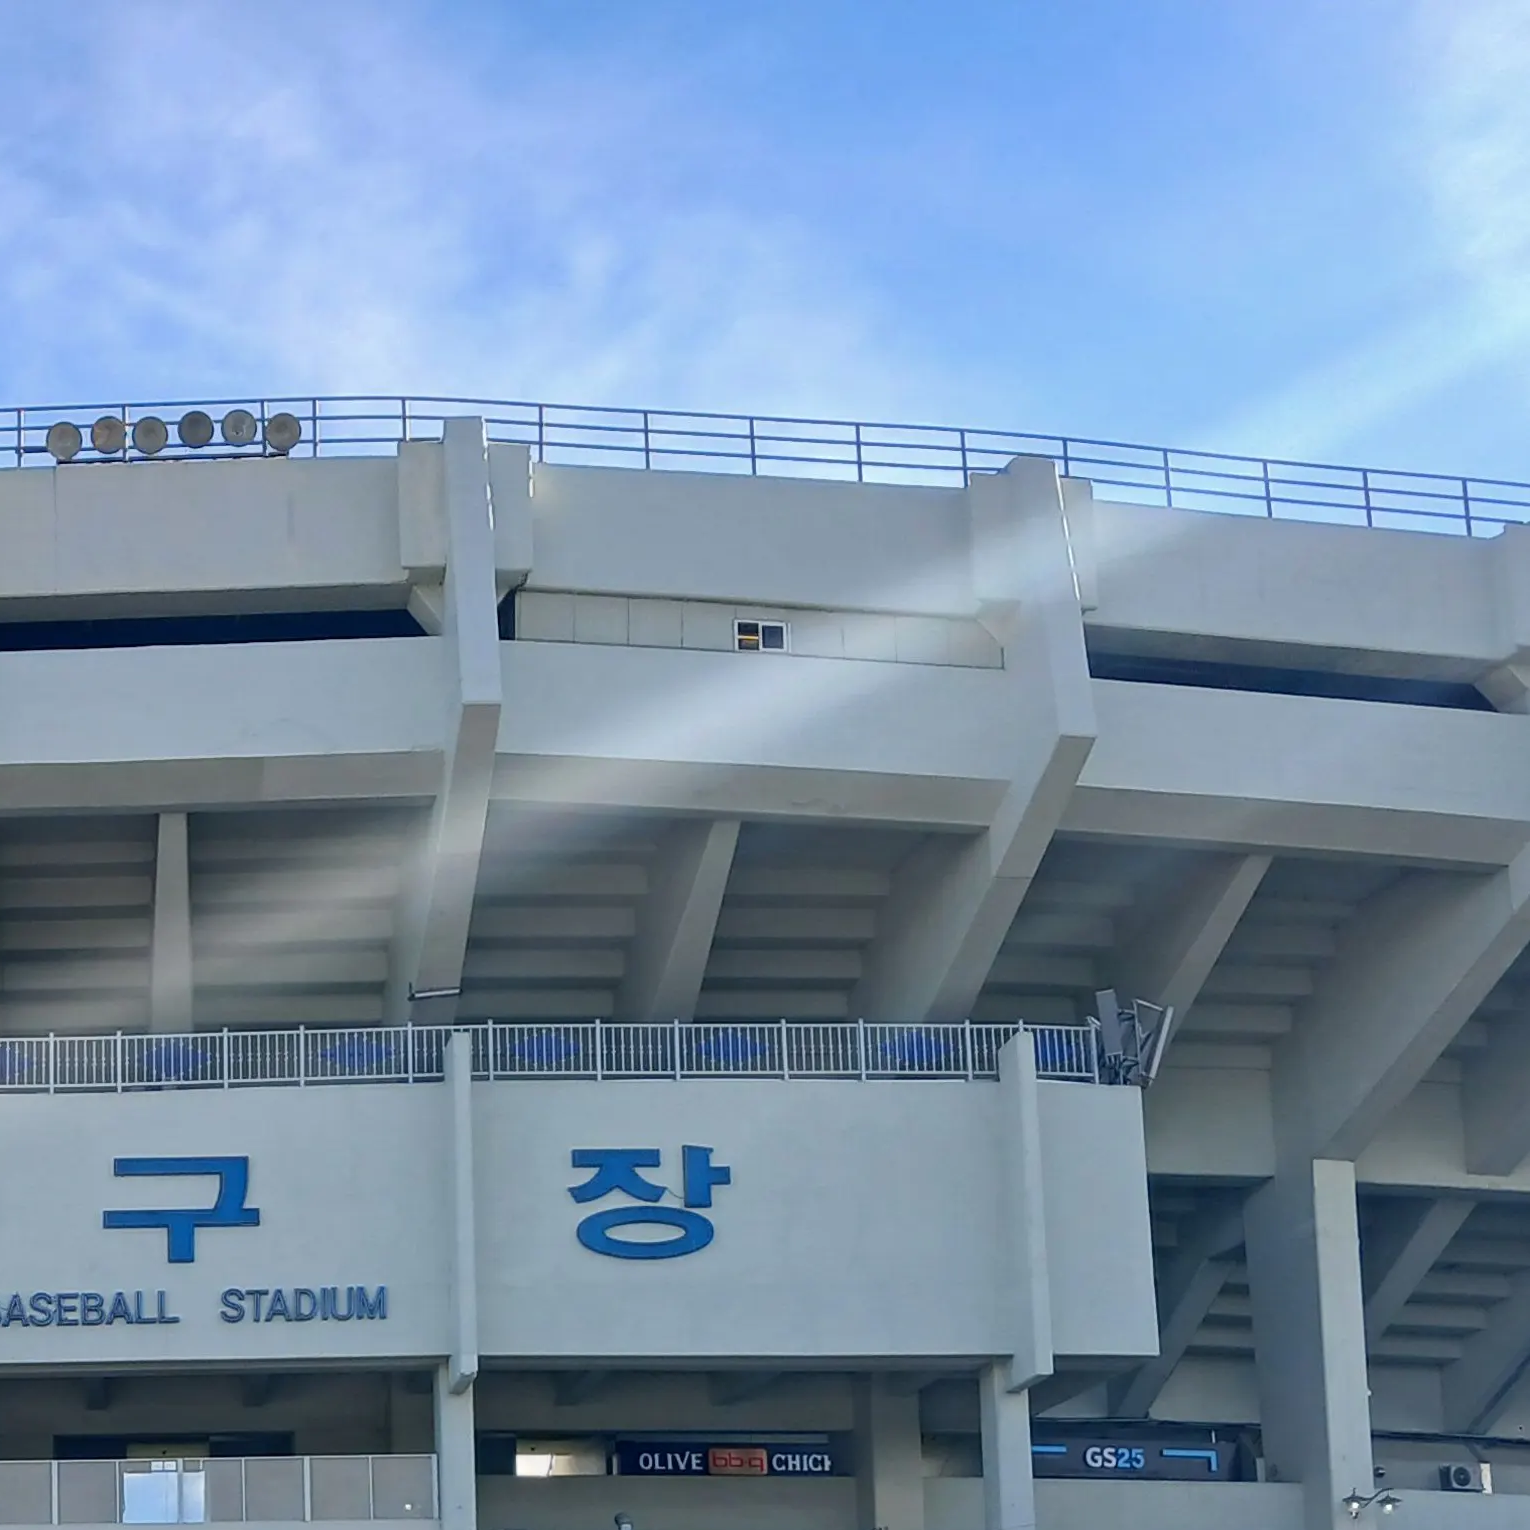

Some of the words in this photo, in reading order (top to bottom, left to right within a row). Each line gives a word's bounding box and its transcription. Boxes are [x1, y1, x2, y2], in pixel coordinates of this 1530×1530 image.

[103, 1155, 260, 1264] 구
[567, 1144, 731, 1260] 장
[219, 1285, 387, 1323] STADIUM
[638, 1451, 704, 1471] OLIVE
[1085, 1446, 1145, 1469] GS25
